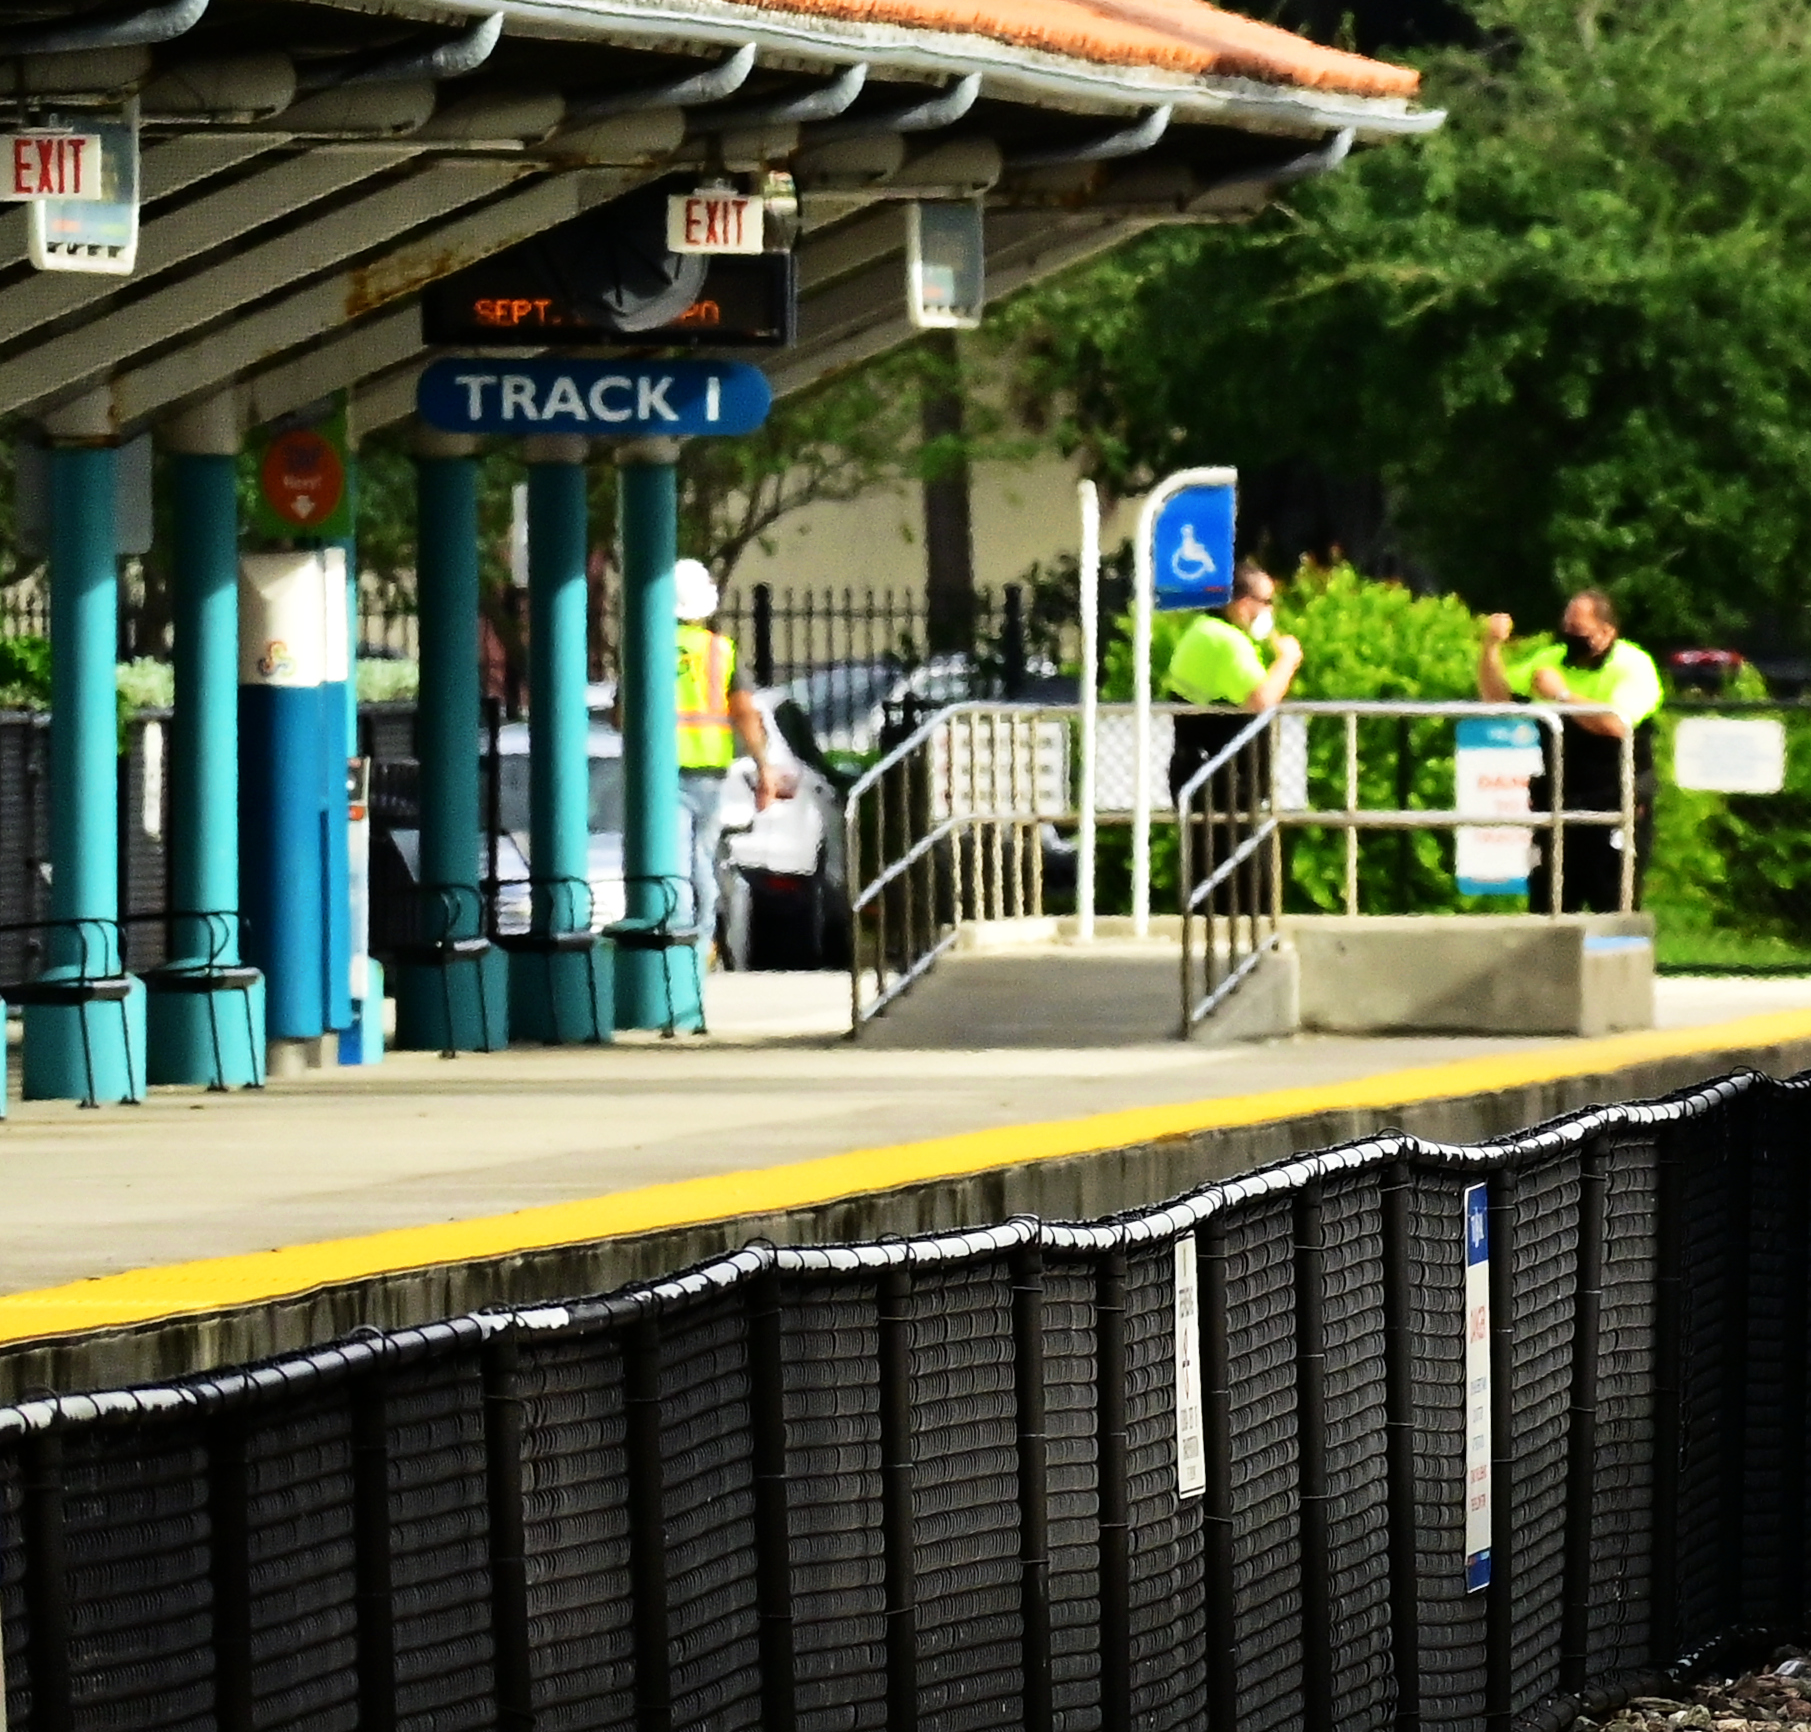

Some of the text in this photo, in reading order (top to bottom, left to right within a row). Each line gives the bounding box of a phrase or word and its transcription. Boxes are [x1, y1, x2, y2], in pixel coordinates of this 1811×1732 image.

[13, 139, 86, 194] EXIT
[685, 199, 748, 245] EXIT
[455, 374, 680, 423] TRACK
